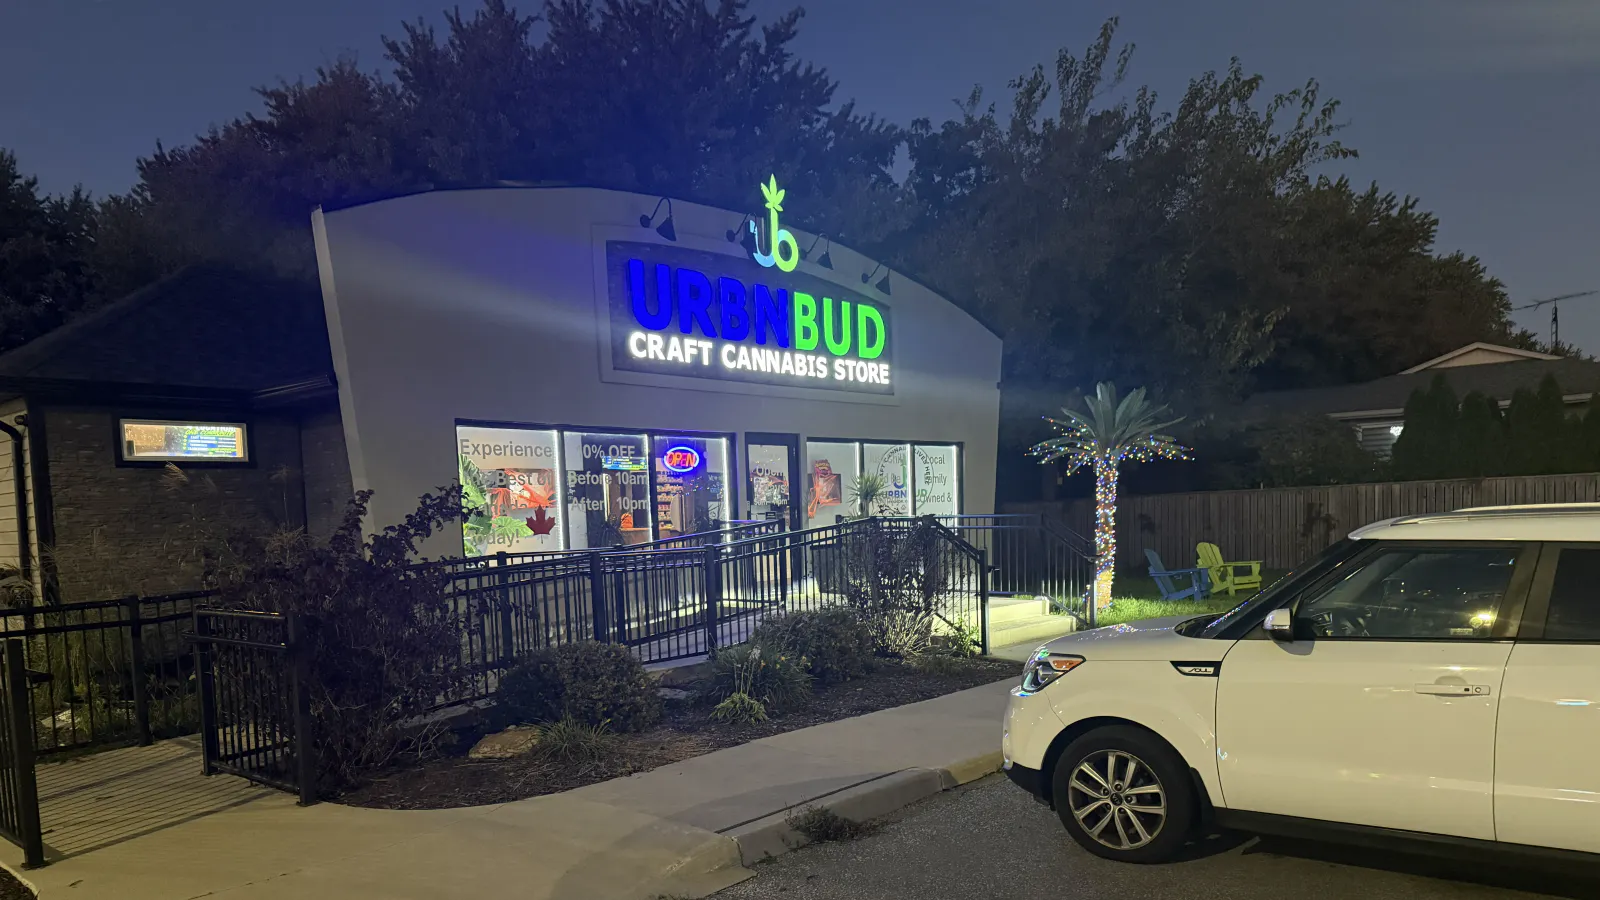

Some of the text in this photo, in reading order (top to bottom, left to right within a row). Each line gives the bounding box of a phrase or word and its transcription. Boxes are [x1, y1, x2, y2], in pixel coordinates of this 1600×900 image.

[629, 331, 890, 386] CRAFT CANNABIS STORE
[460, 438, 553, 460] Experience
[608, 444, 636, 460] OFF
[666, 452, 697, 468] OPEN
[496, 469, 533, 487] Best
[568, 470, 613, 486] Before
[615, 471, 648, 486] 10am
[571, 497, 650, 514] After 10pm
